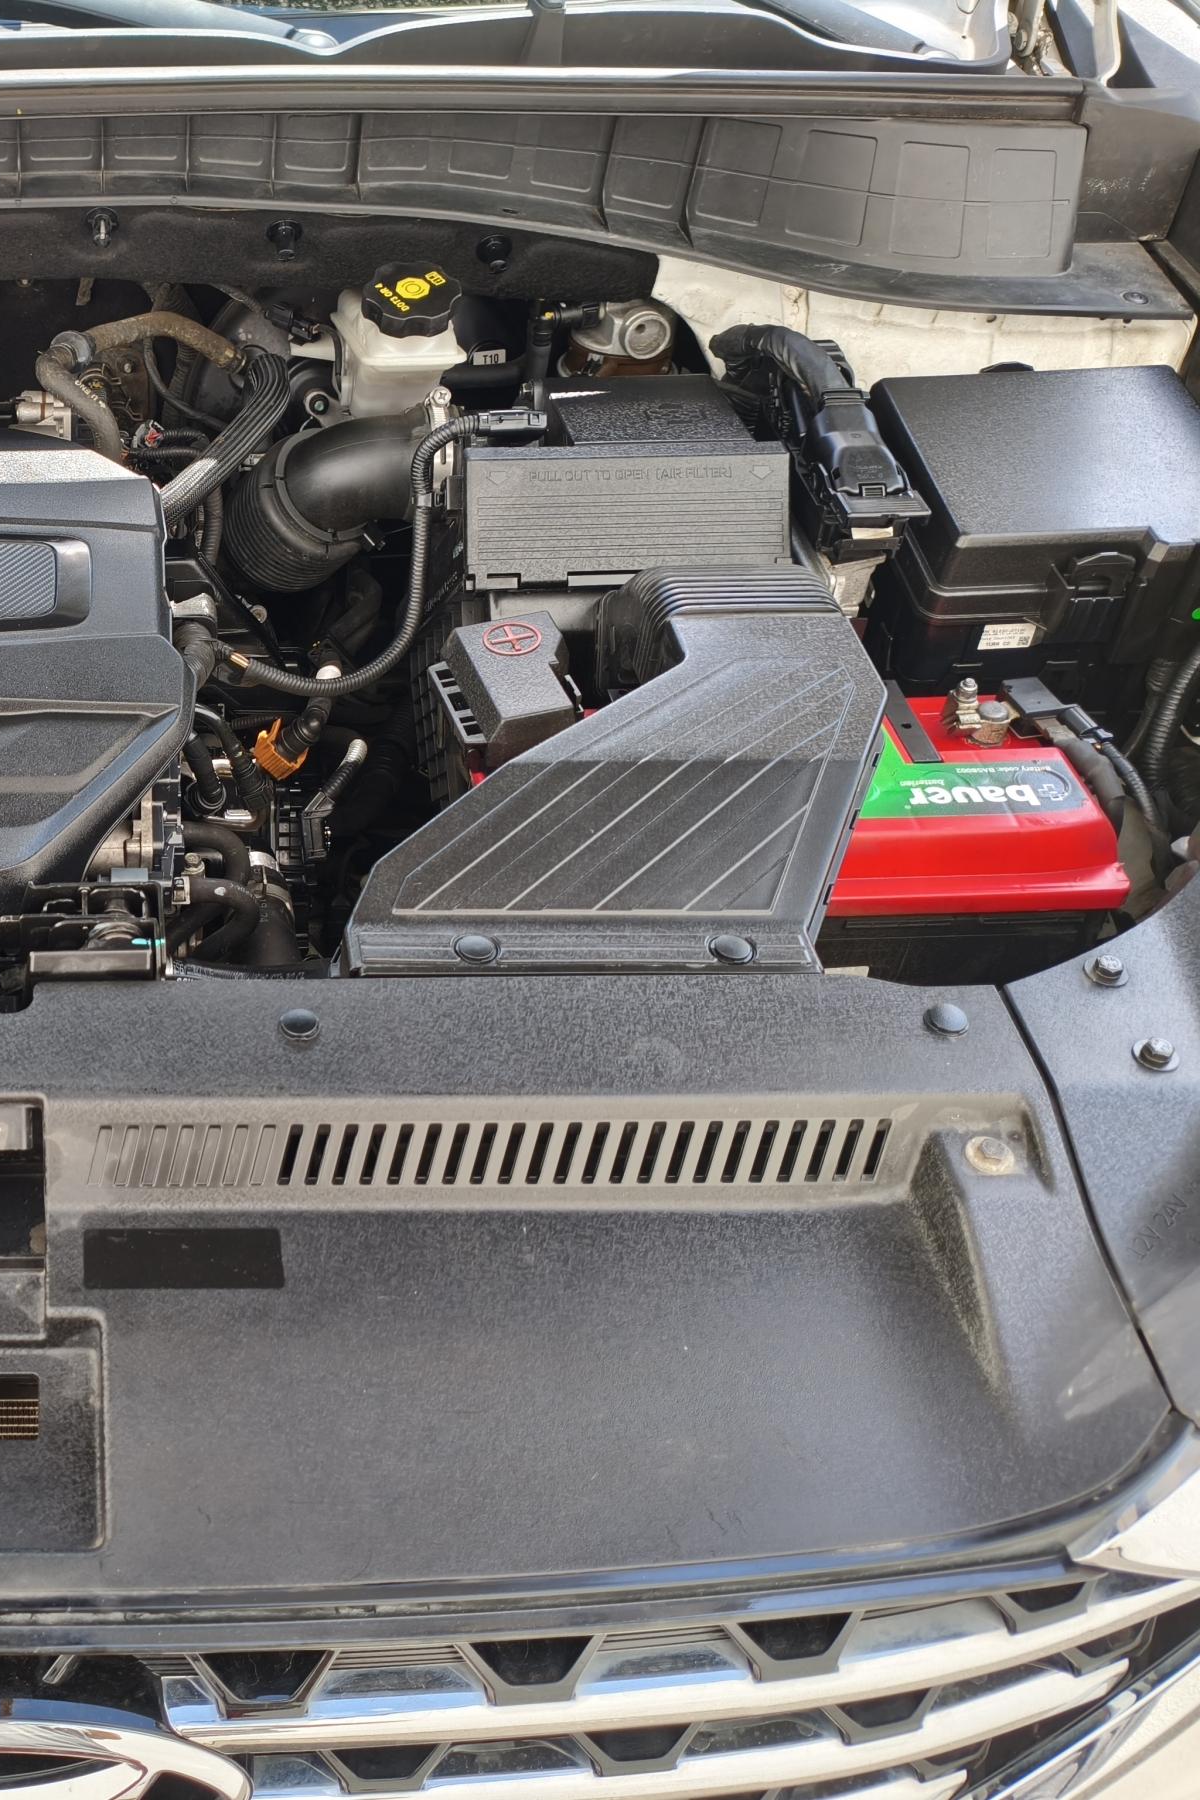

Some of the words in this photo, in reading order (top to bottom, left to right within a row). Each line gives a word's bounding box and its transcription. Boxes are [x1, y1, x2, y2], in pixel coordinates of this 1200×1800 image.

[380, 287, 393, 297] OR
[389, 296, 410, 312] DOT3
[482, 353, 499, 365] T10
[529, 470, 562, 482] PULL
[564, 469, 592, 482] OUT
[595, 469, 611, 481] TO
[614, 468, 649, 481] OPEN
[908, 784, 1041, 806] bauer
